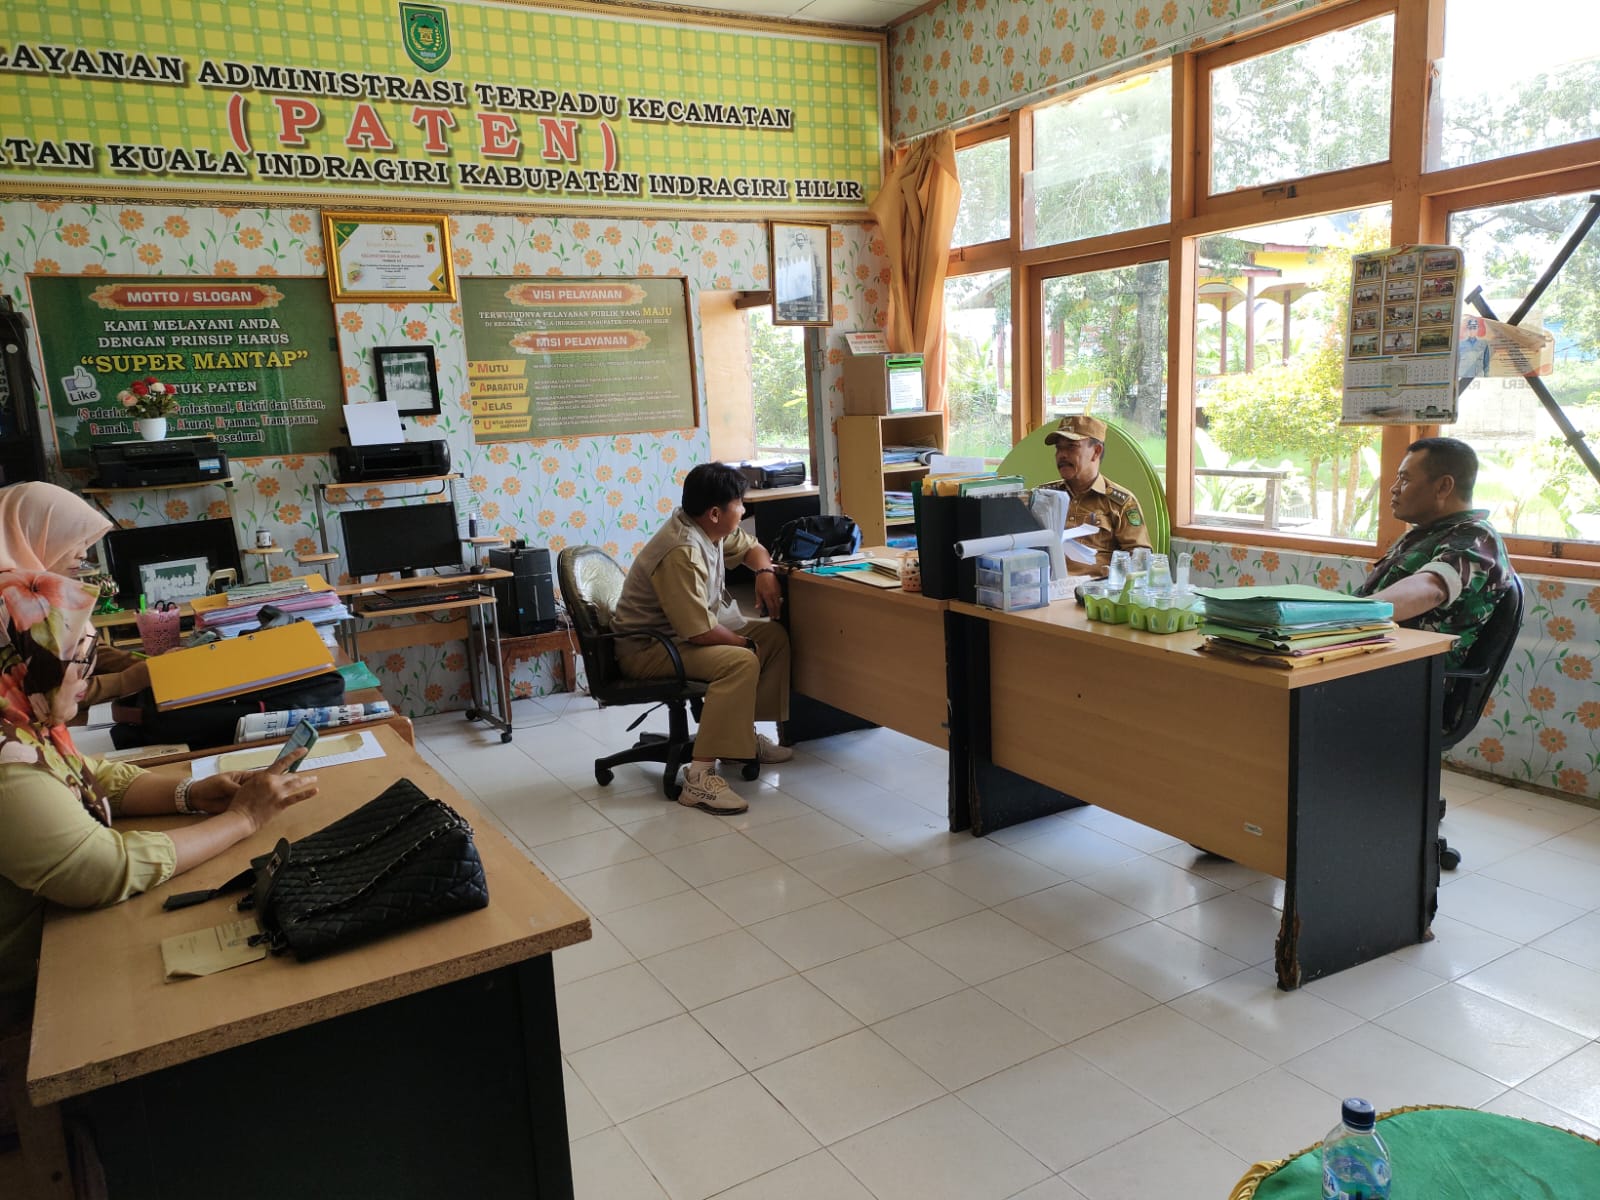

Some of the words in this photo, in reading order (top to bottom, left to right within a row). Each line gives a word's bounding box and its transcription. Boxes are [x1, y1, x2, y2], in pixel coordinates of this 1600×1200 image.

[198, 60, 466, 104] ADMINISTRASI
[474, 83, 618, 116] TERPADU
[627, 98, 793, 128] KECAMATAN
[108, 144, 246, 175] KUALA
[258, 152, 448, 184] INDRAGIRI
[459, 163, 640, 193] KABUPATEN
[648, 174, 788, 199] INDRAGIRI
[794, 181, 863, 200] HILIR
[127, 291, 179, 303] MOTTO
[193, 290, 252, 303] SLOGAN
[532, 290, 556, 300] VISI
[559, 289, 623, 300] PELAYANAN
[643, 307, 672, 317] MAJU
[104, 321, 148, 332] KAMI
[151, 319, 234, 332] MELAYANI
[239, 318, 280, 330] ANDA
[98, 336, 166, 348] DENGAN
[171, 335, 233, 347] PRINSIP
[238, 333, 290, 346] HARUS
[564, 335, 628, 347] PELAYANAN
[477, 363, 509, 373] MUTU
[208, 381, 257, 393] PATEN
[479, 382, 524, 392] APARATUR
[70, 389, 97, 402] Like
[271, 400, 289, 411] dan
[481, 401, 513, 411] JELAS
